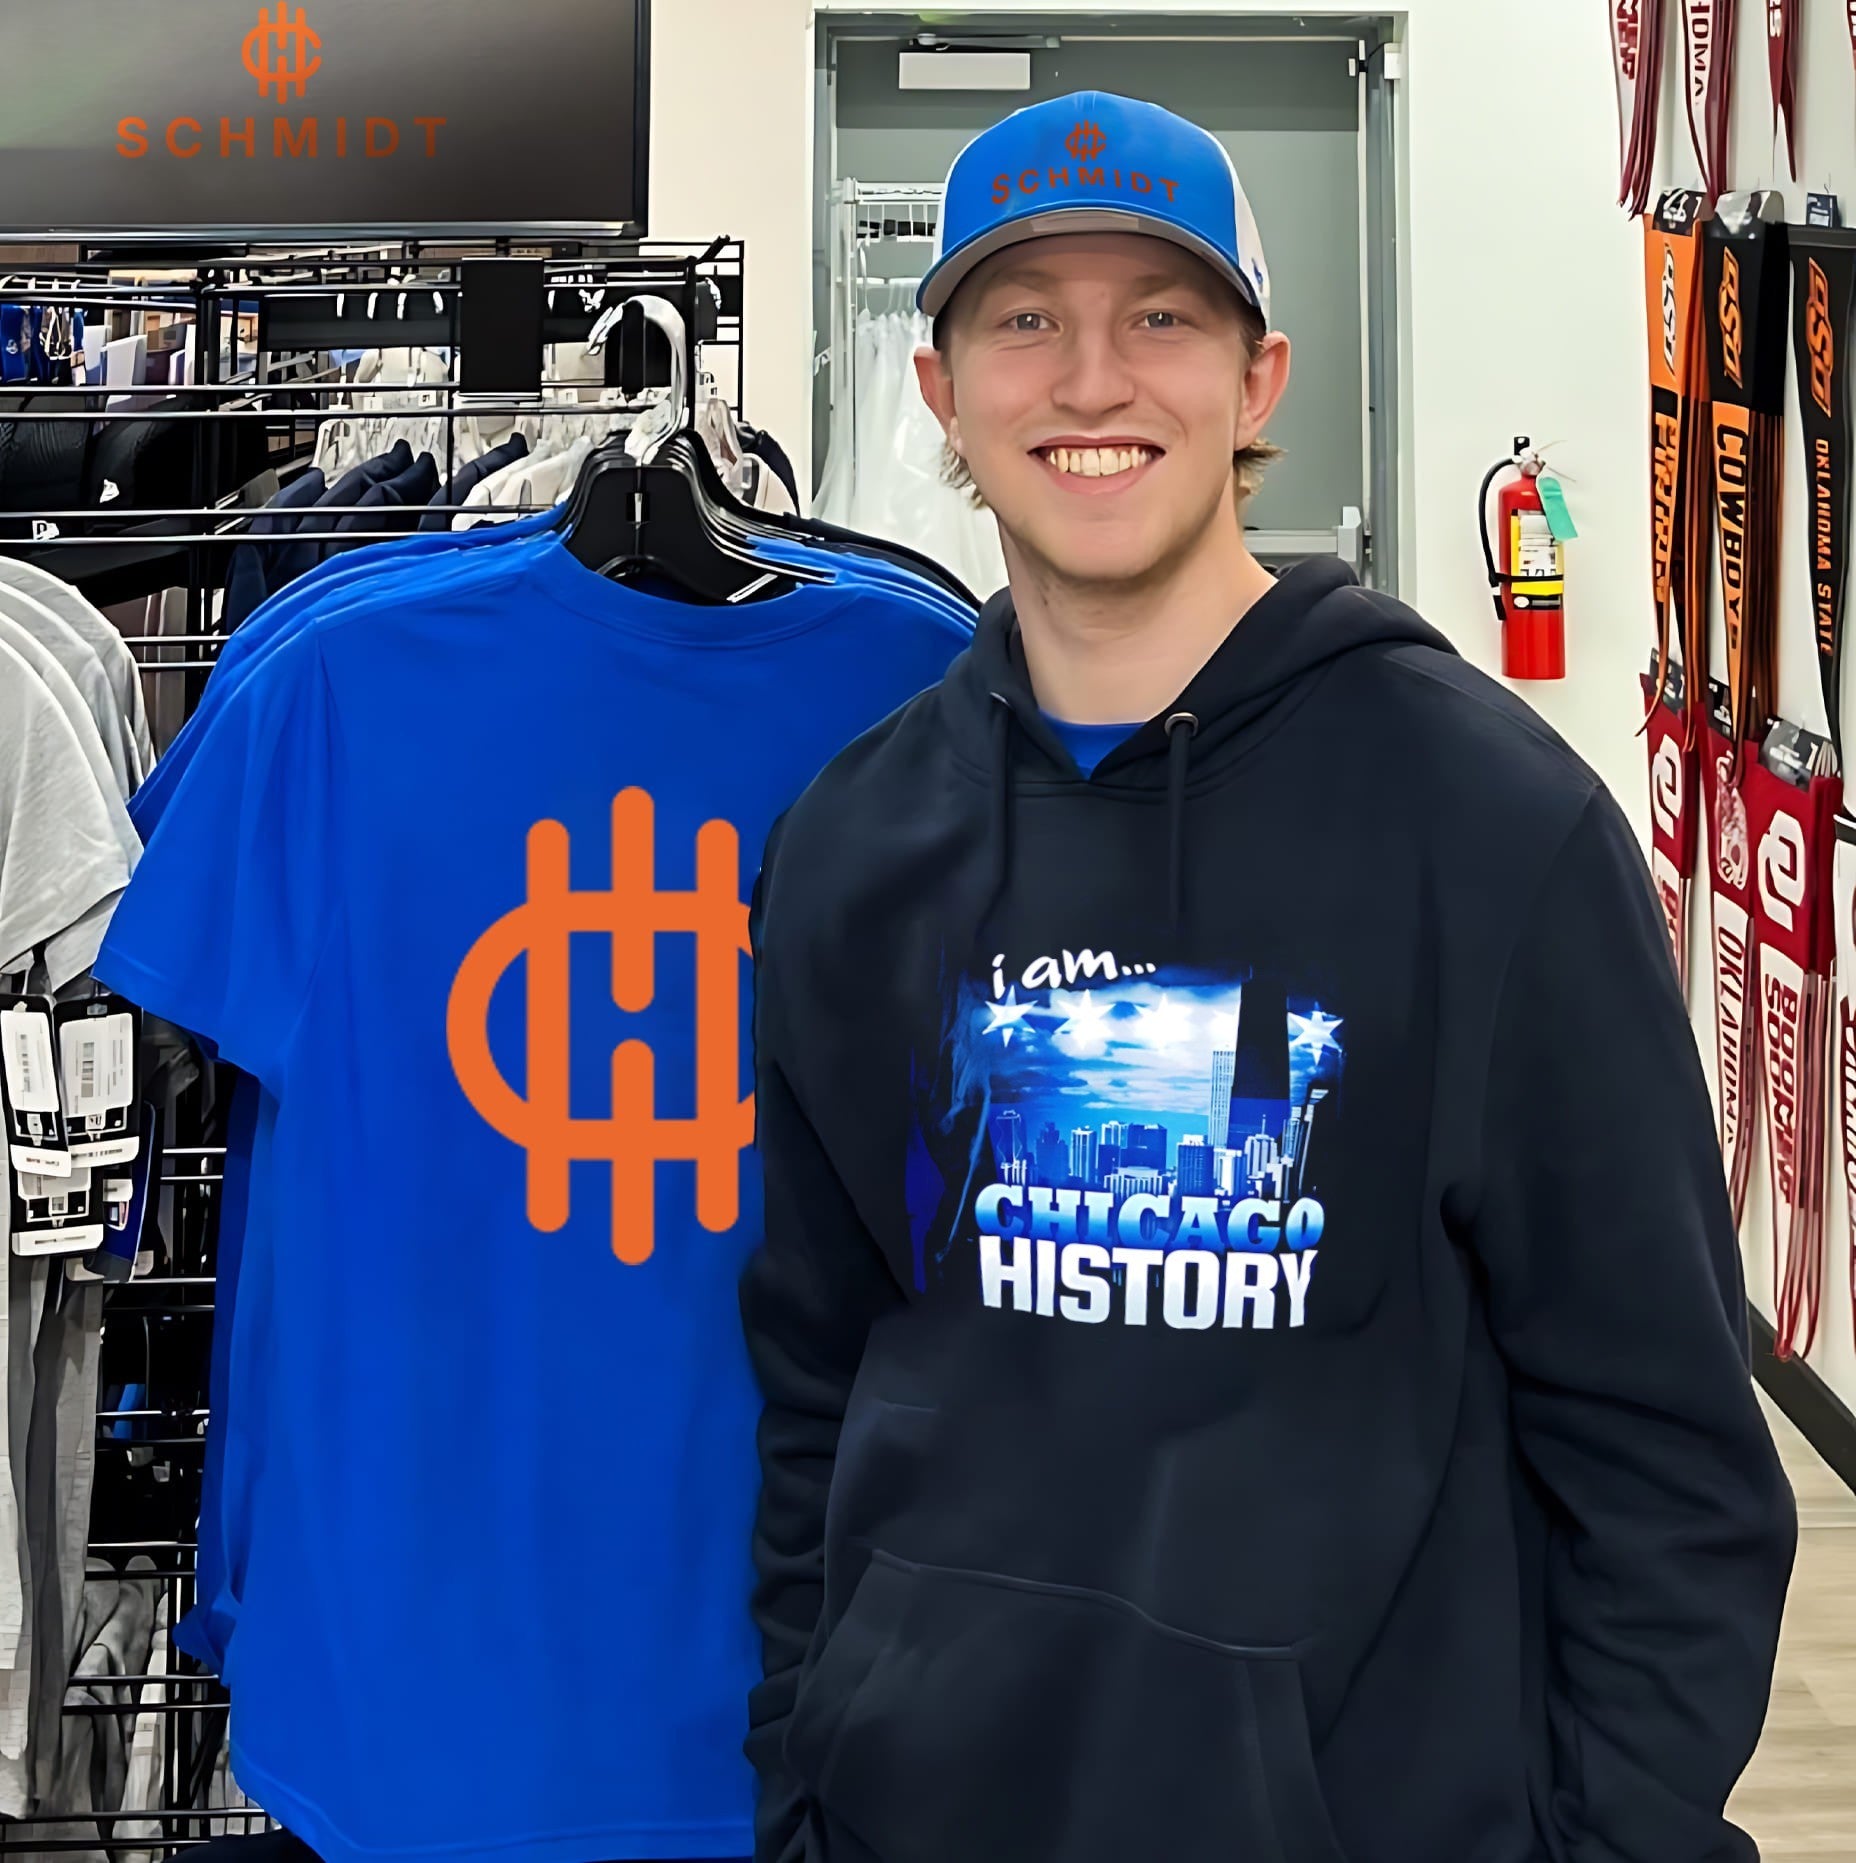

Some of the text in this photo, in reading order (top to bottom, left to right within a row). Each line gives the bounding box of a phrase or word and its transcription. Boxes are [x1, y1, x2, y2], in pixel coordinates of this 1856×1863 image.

[116, 117, 447, 158] SCHMIDT
[991, 166, 1179, 204] SCHMIDT
[1815, 438, 1832, 570] OKLAHOMA
[991, 953, 1006, 999] i
[975, 1183, 1325, 1253] CHICAGO
[979, 1235, 1319, 1330] HISTORY
